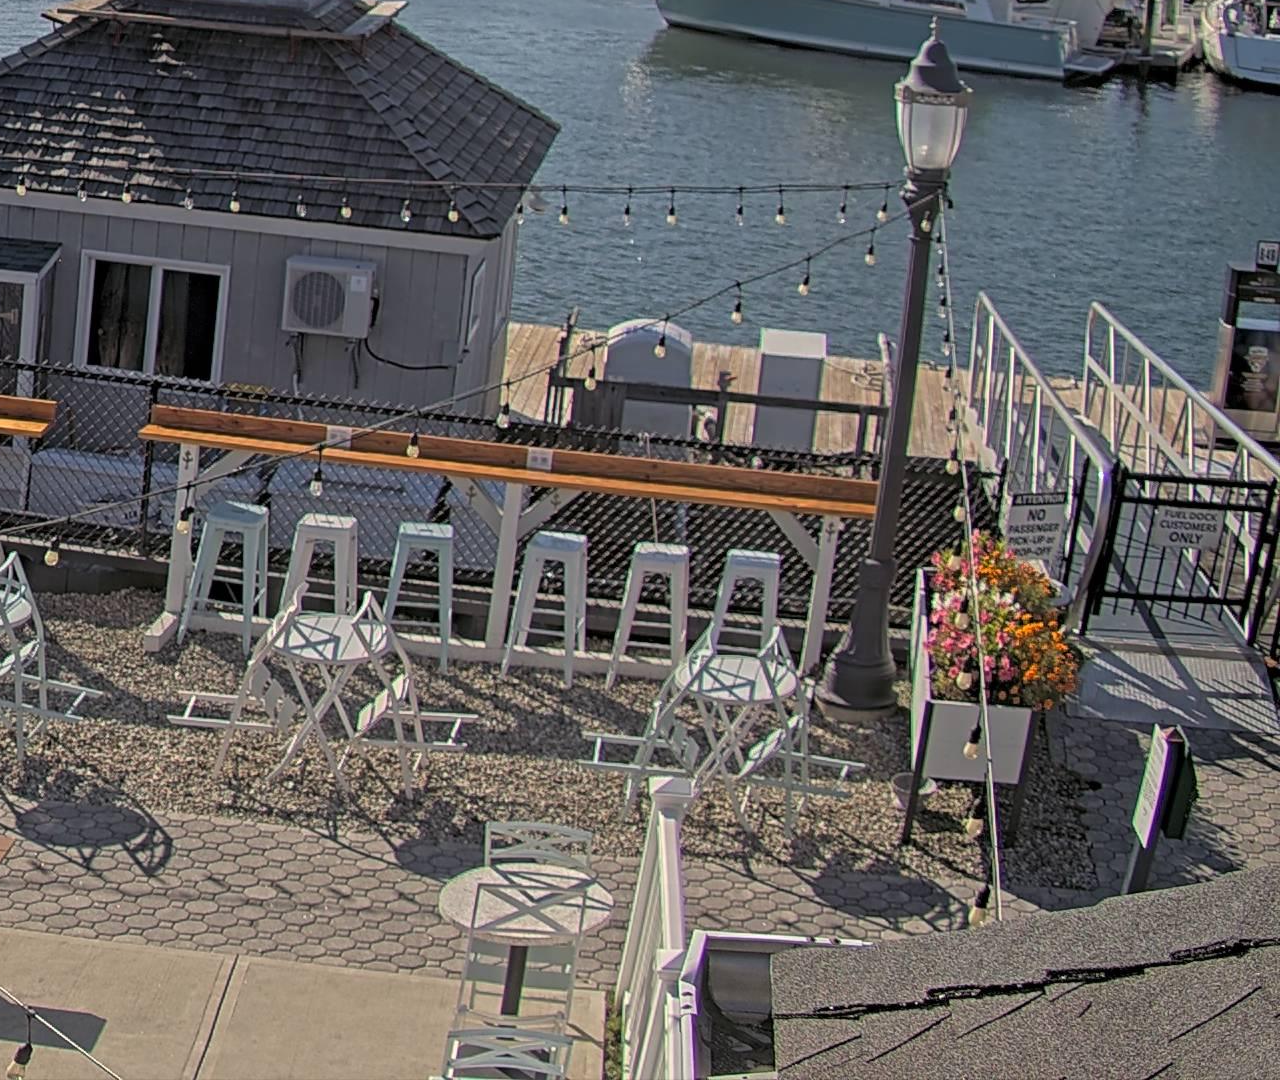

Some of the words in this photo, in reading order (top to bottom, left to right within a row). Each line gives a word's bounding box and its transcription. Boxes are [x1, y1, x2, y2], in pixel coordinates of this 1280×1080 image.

[1015, 494, 1065, 505] ATTENTION
[1027, 509, 1046, 522] NO
[1164, 509, 1187, 520] FUEL
[1189, 512, 1218, 522] DOCK
[1008, 522, 1060, 534] PASSENGER
[1159, 519, 1218, 533] CUSTOMERS
[1169, 531, 1203, 544] ONLY
